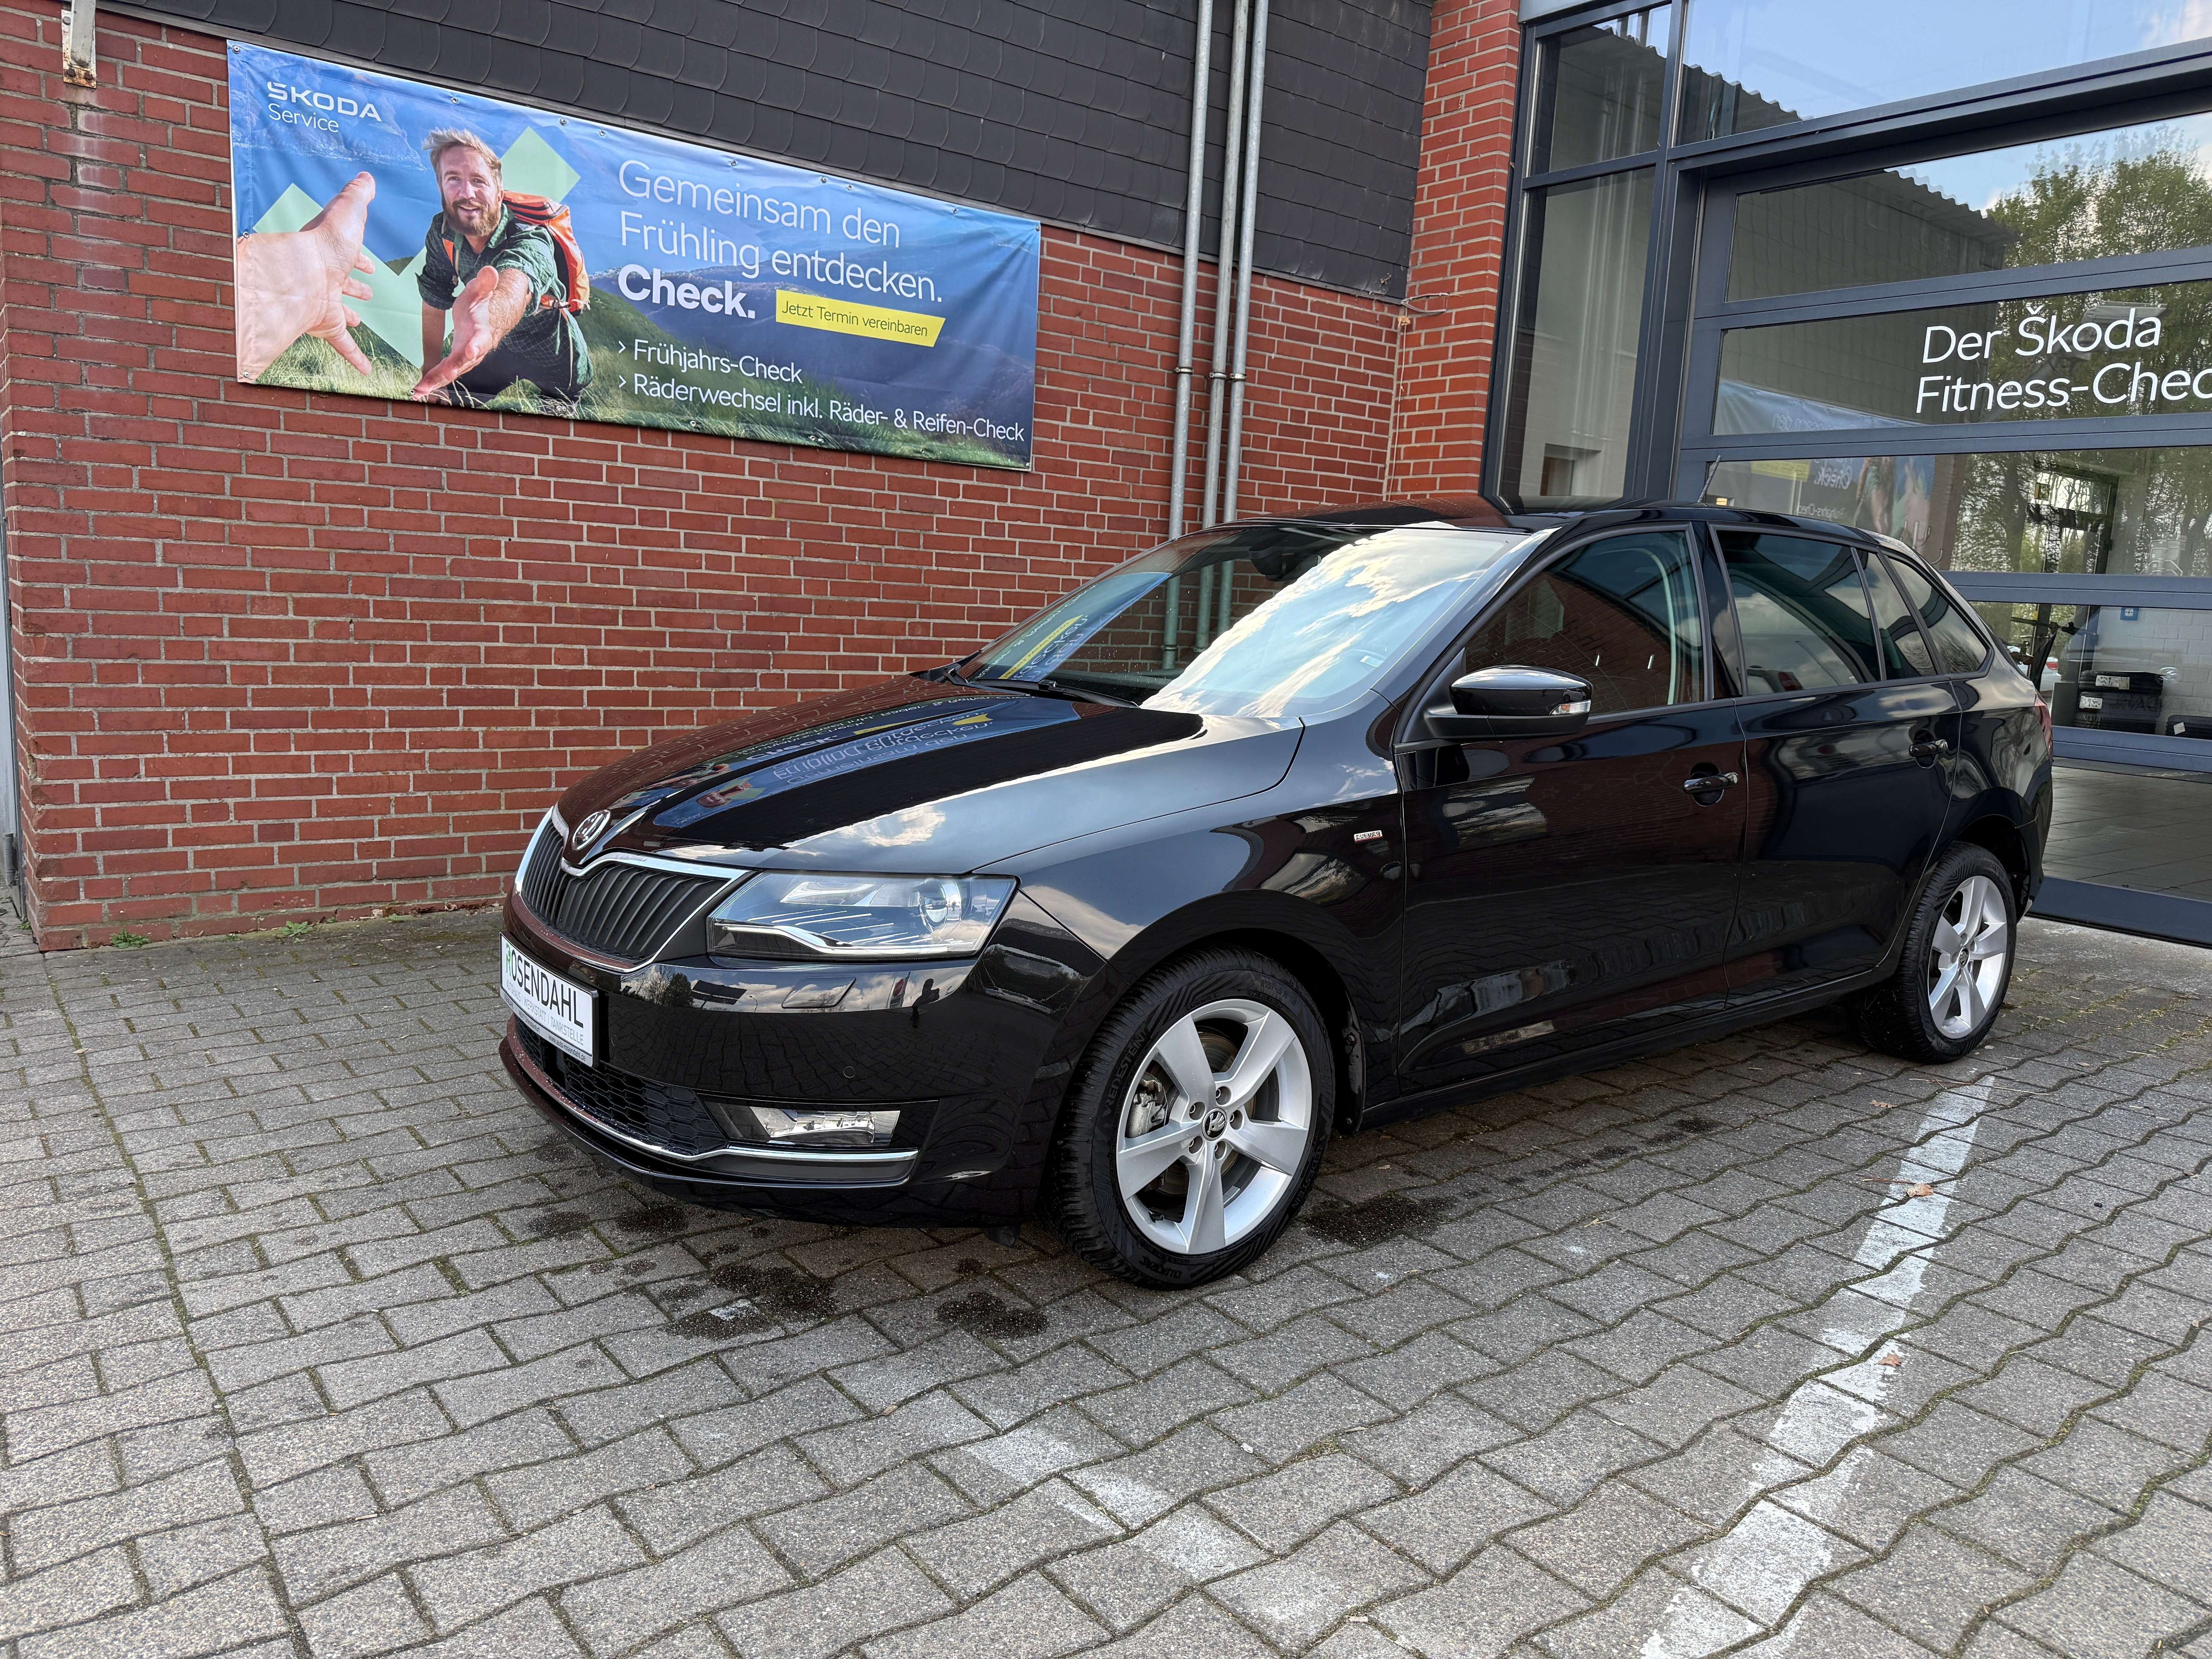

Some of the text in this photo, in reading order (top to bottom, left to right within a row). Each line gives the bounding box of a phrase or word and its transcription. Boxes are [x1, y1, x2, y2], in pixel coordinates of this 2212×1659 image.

[268, 103, 339, 133] Service
[619, 160, 900, 248] Gemeinsam den
[620, 210, 942, 302] Frühling entdecken.
[618, 264, 755, 319] Check.
[781, 300, 928, 337] Jetzt Termin vereinbaren
[634, 339, 803, 384] Frühjahrs-Check
[1923, 305, 2161, 363] Der Škoda
[634, 373, 1024, 442] Räderwechsel inkl. Räder- & Reifen-Check
[506, 943, 584, 1029] ROSENDAHL
[550, 1017, 584, 1046] TANKSTELLE
[1102, 1034, 1146, 1118] VREDESTEIN
